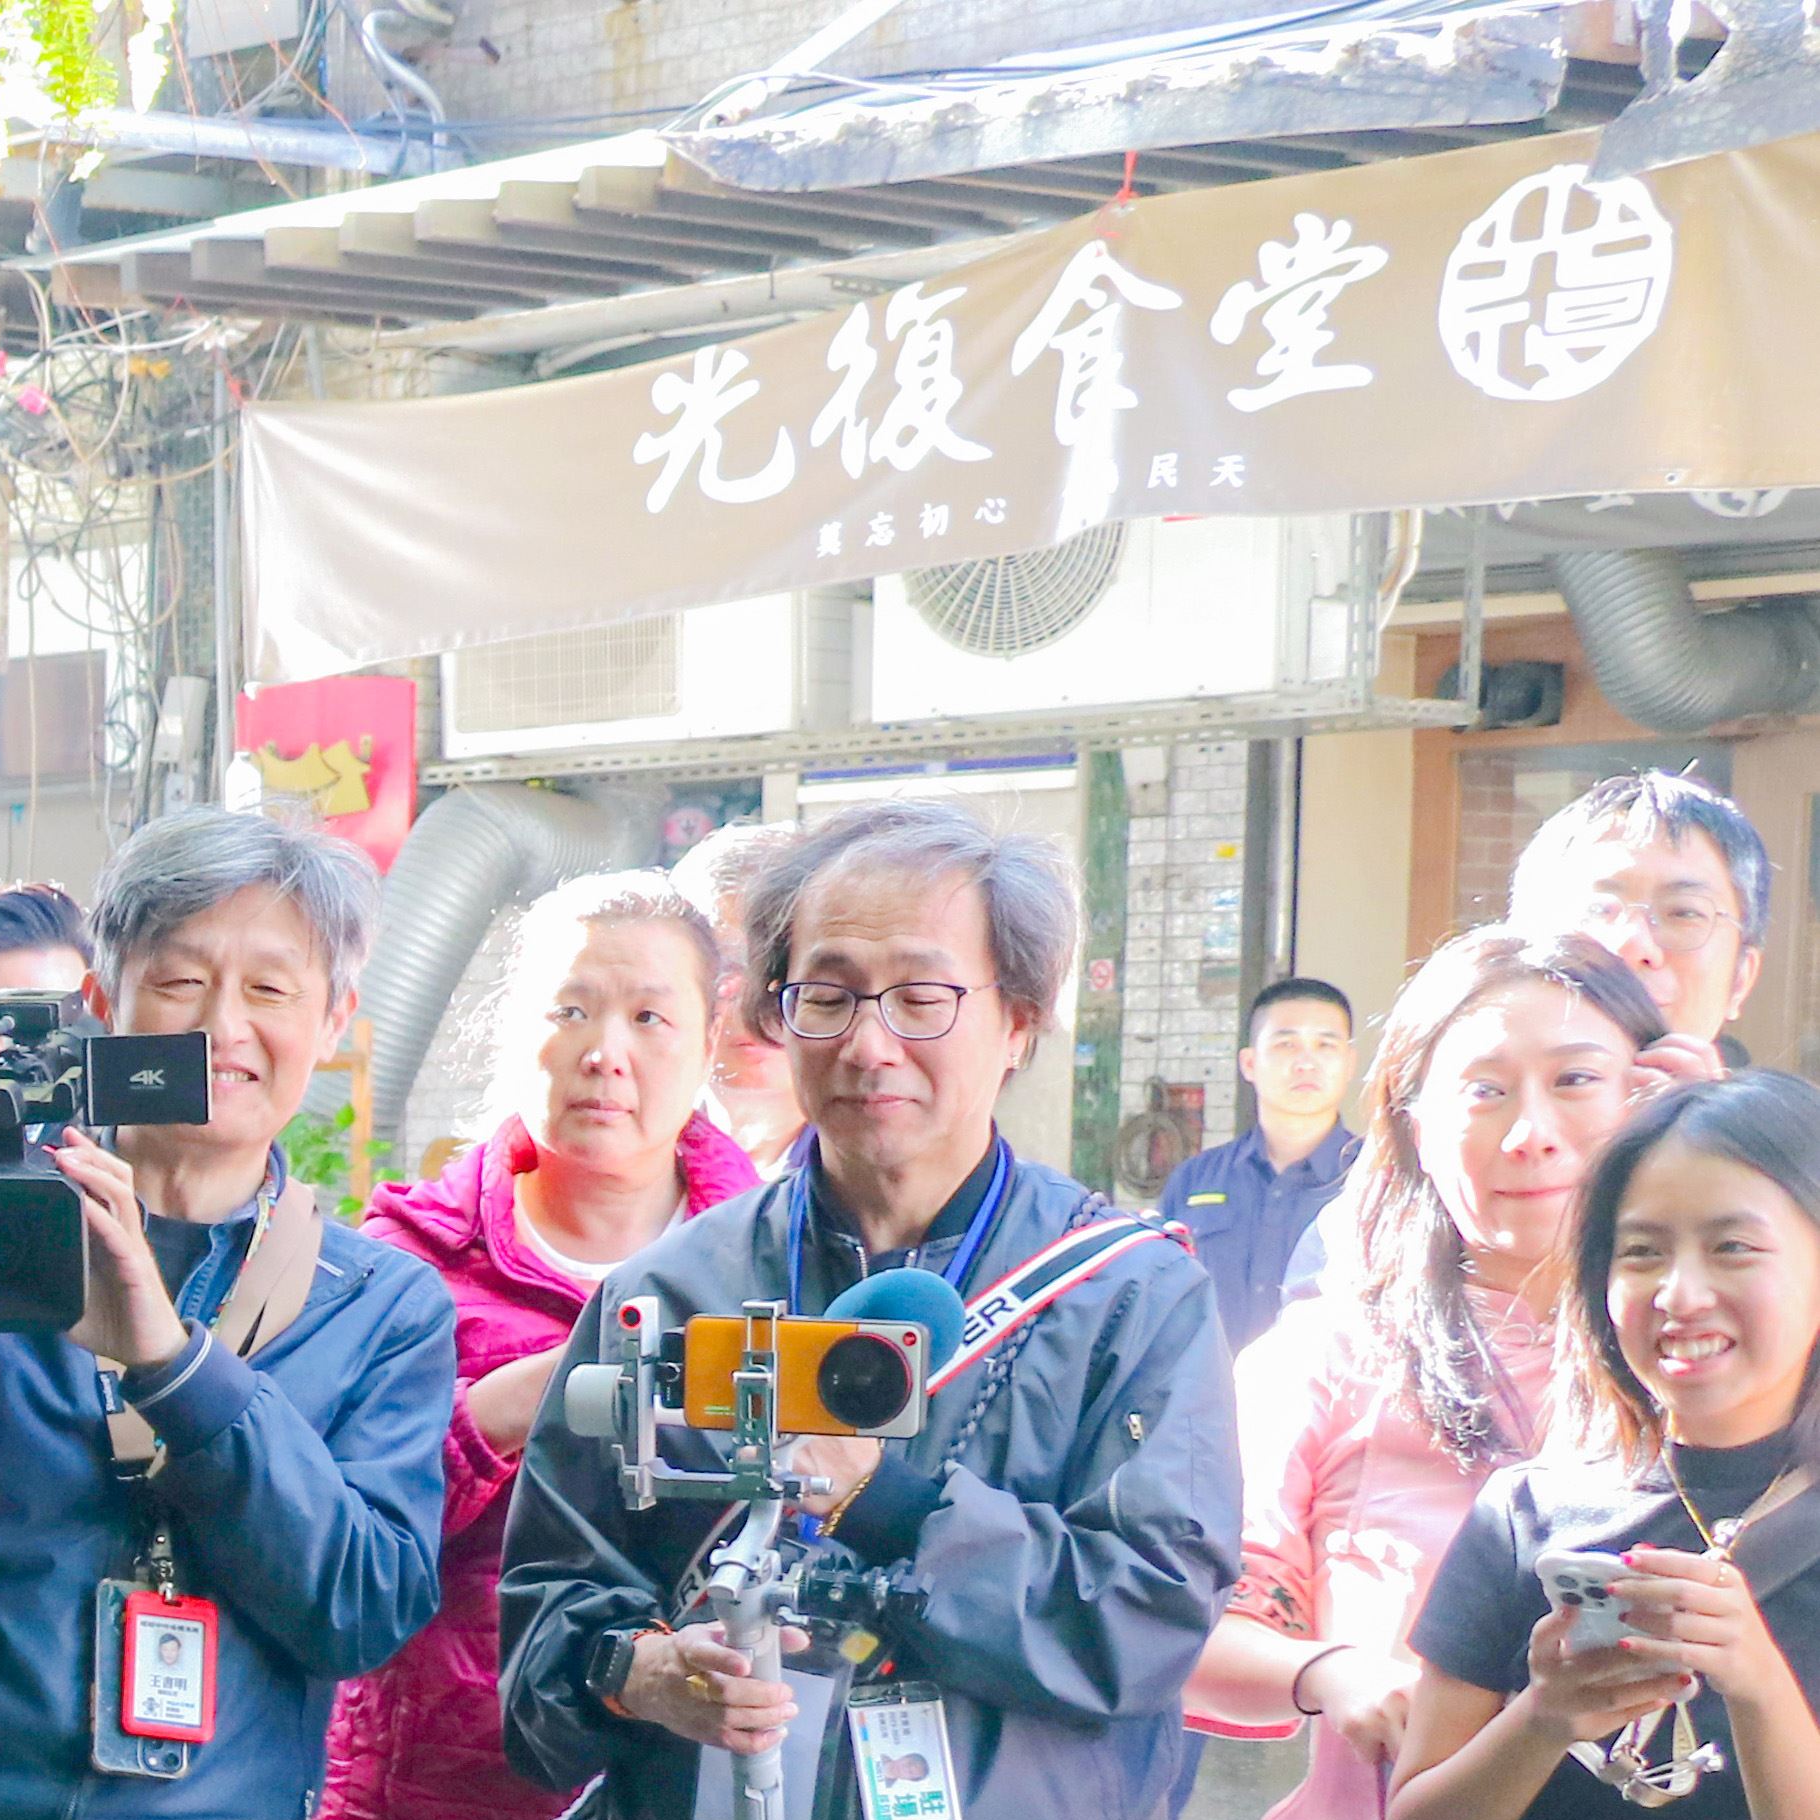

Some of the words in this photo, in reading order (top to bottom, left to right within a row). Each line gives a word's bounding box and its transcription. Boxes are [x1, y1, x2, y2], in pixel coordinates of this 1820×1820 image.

[634, 211, 1390, 513] 光復食堂
[129, 1069, 166, 1087] 4K
